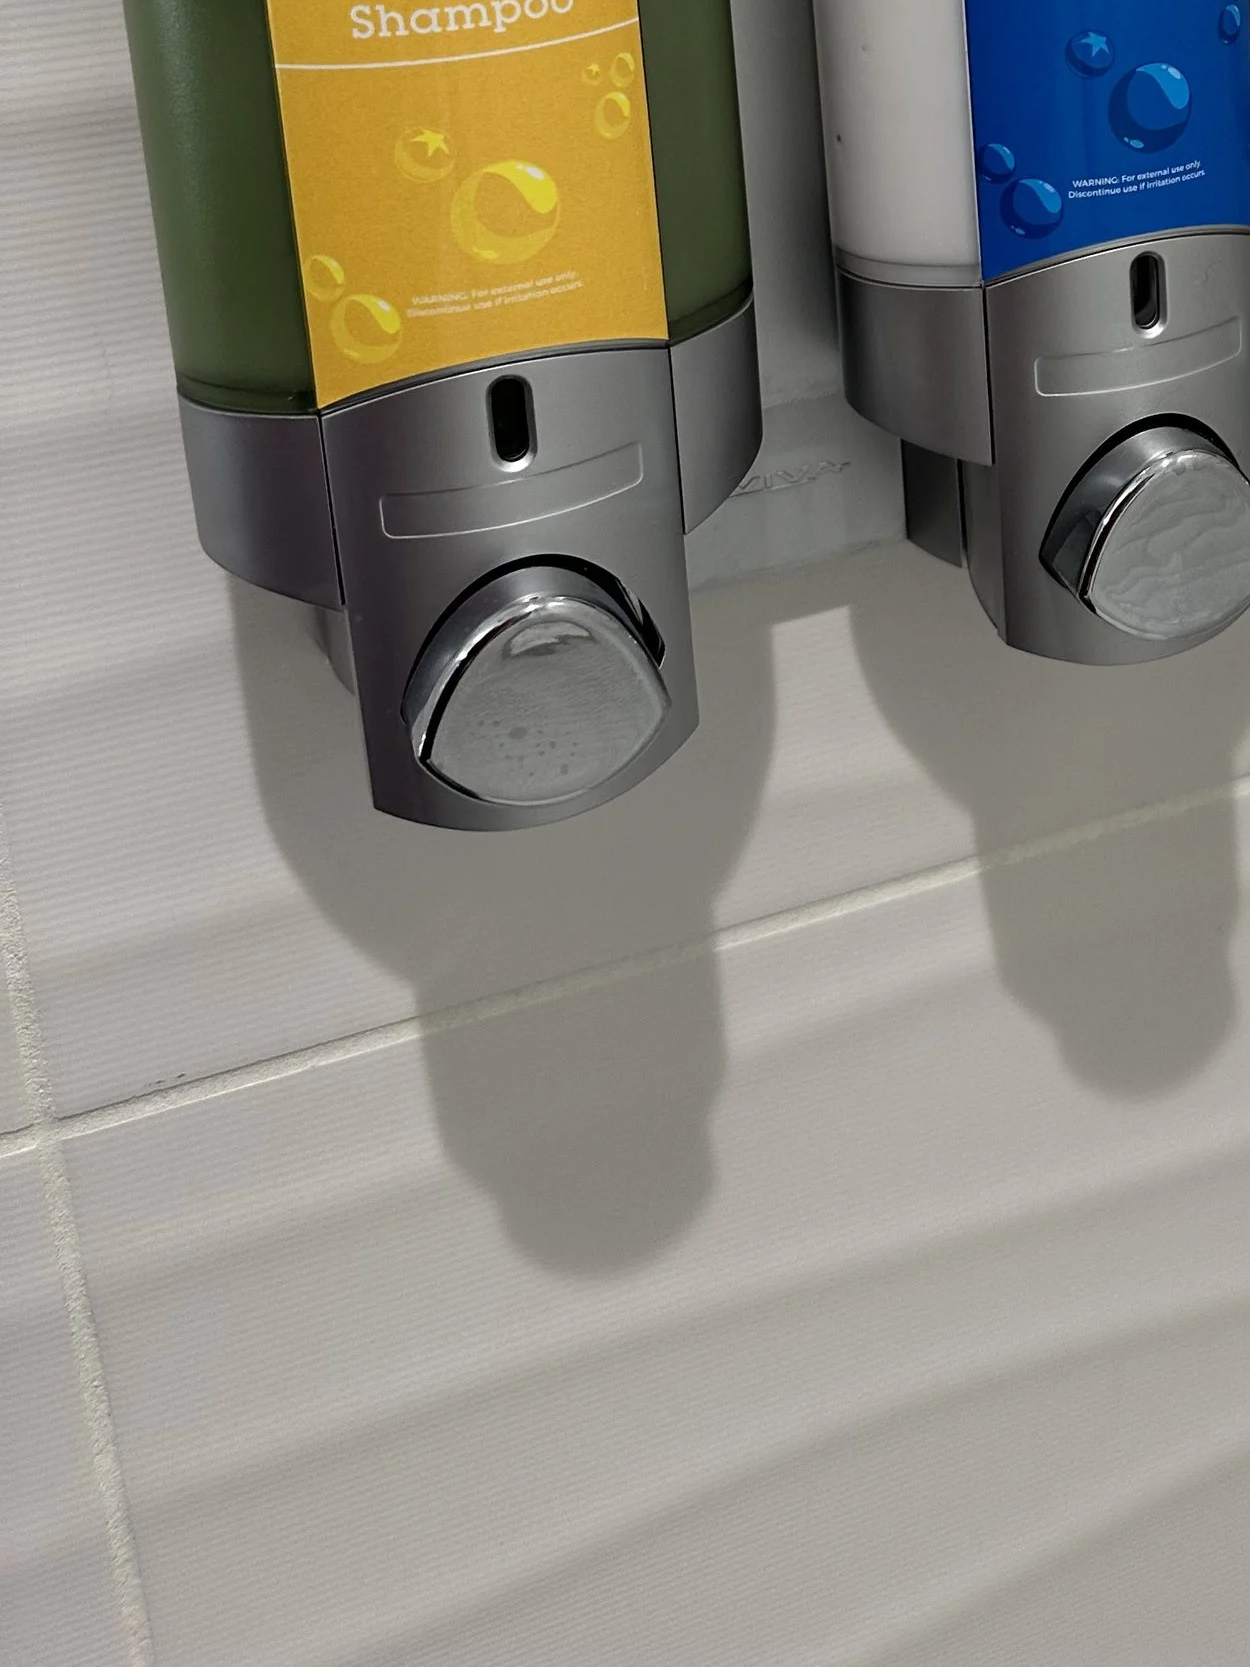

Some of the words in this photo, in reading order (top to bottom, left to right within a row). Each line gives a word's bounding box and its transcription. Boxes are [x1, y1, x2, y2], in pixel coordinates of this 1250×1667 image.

[1137, 167, 1169, 180] external
[1171, 165, 1184, 173] use
[1068, 188, 1121, 198] Discontinue
[1123, 185, 1138, 193] use
[1147, 176, 1180, 189] irritation
